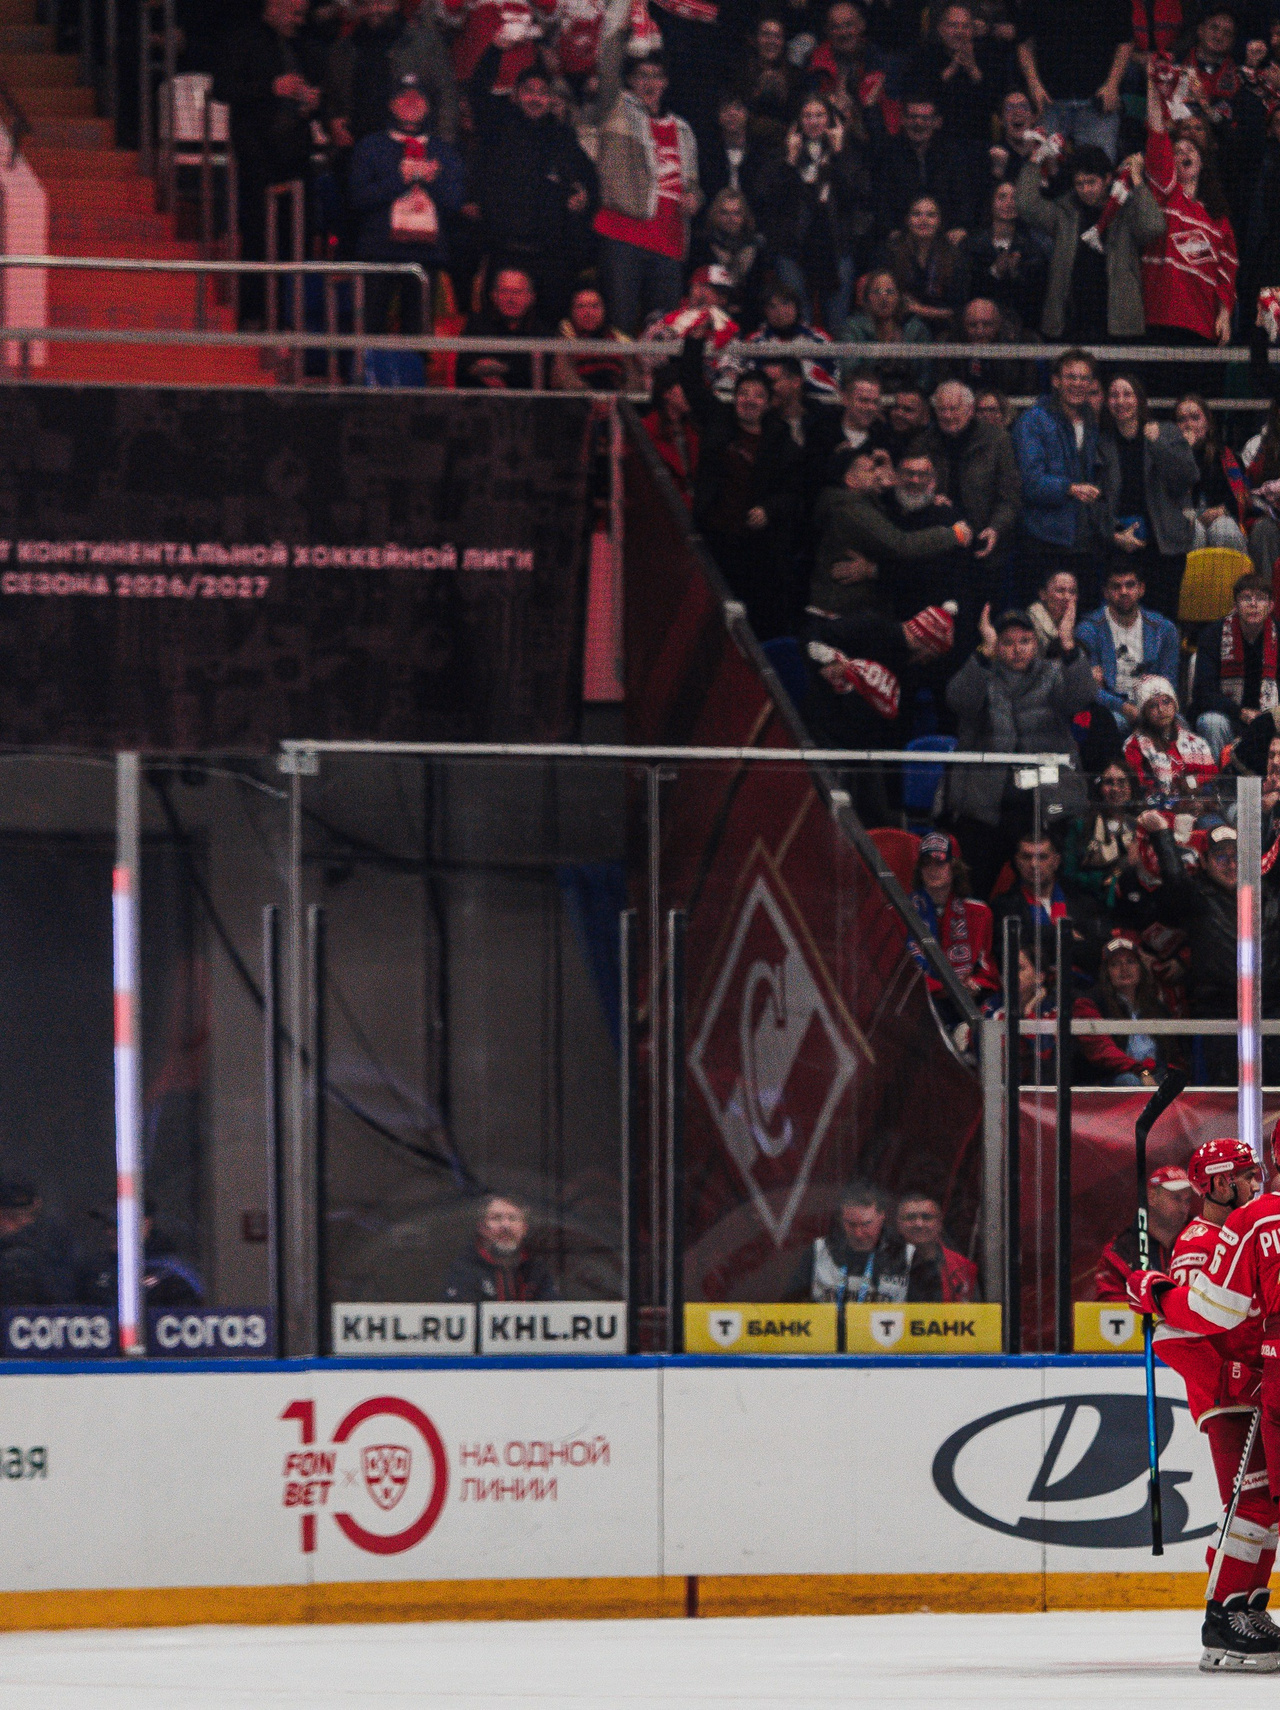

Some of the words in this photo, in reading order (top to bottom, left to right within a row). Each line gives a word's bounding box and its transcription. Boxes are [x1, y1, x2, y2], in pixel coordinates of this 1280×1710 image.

[17, 540, 288, 569] КОНТИНЕНТАЛЬНОЙ
[293, 543, 457, 571] ХОККЕЙНОЙ
[1, 571, 109, 597] СЕЗОНА
[342, 1315, 467, 1343] KHL.RU
[490, 1313, 619, 1341] KHL.RU
[747, 1320, 812, 1337] БАНК
[909, 1320, 975, 1337] БАНК
[283, 1452, 336, 1477] FON
[459, 1441, 500, 1467] НА
[503, 1434, 611, 1472] ОДНОЙ
[283, 1480, 334, 1507] BET
[459, 1475, 558, 1502] ЛИНИИ
